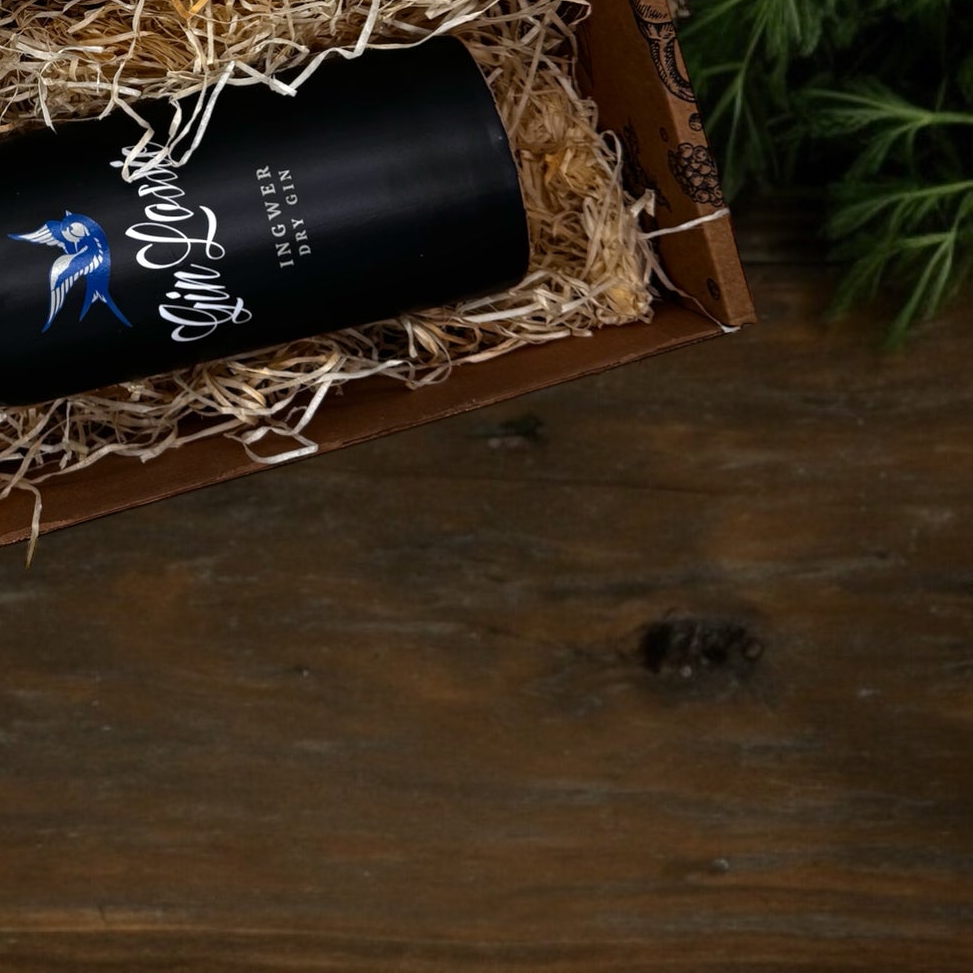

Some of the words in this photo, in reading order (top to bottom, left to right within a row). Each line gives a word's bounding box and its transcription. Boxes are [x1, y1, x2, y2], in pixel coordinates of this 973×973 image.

[278, 169, 299, 205] GIN
[256, 165, 295, 268] INGWER
[291, 218, 312, 256] DRY
[159, 263, 253, 342] Gin
